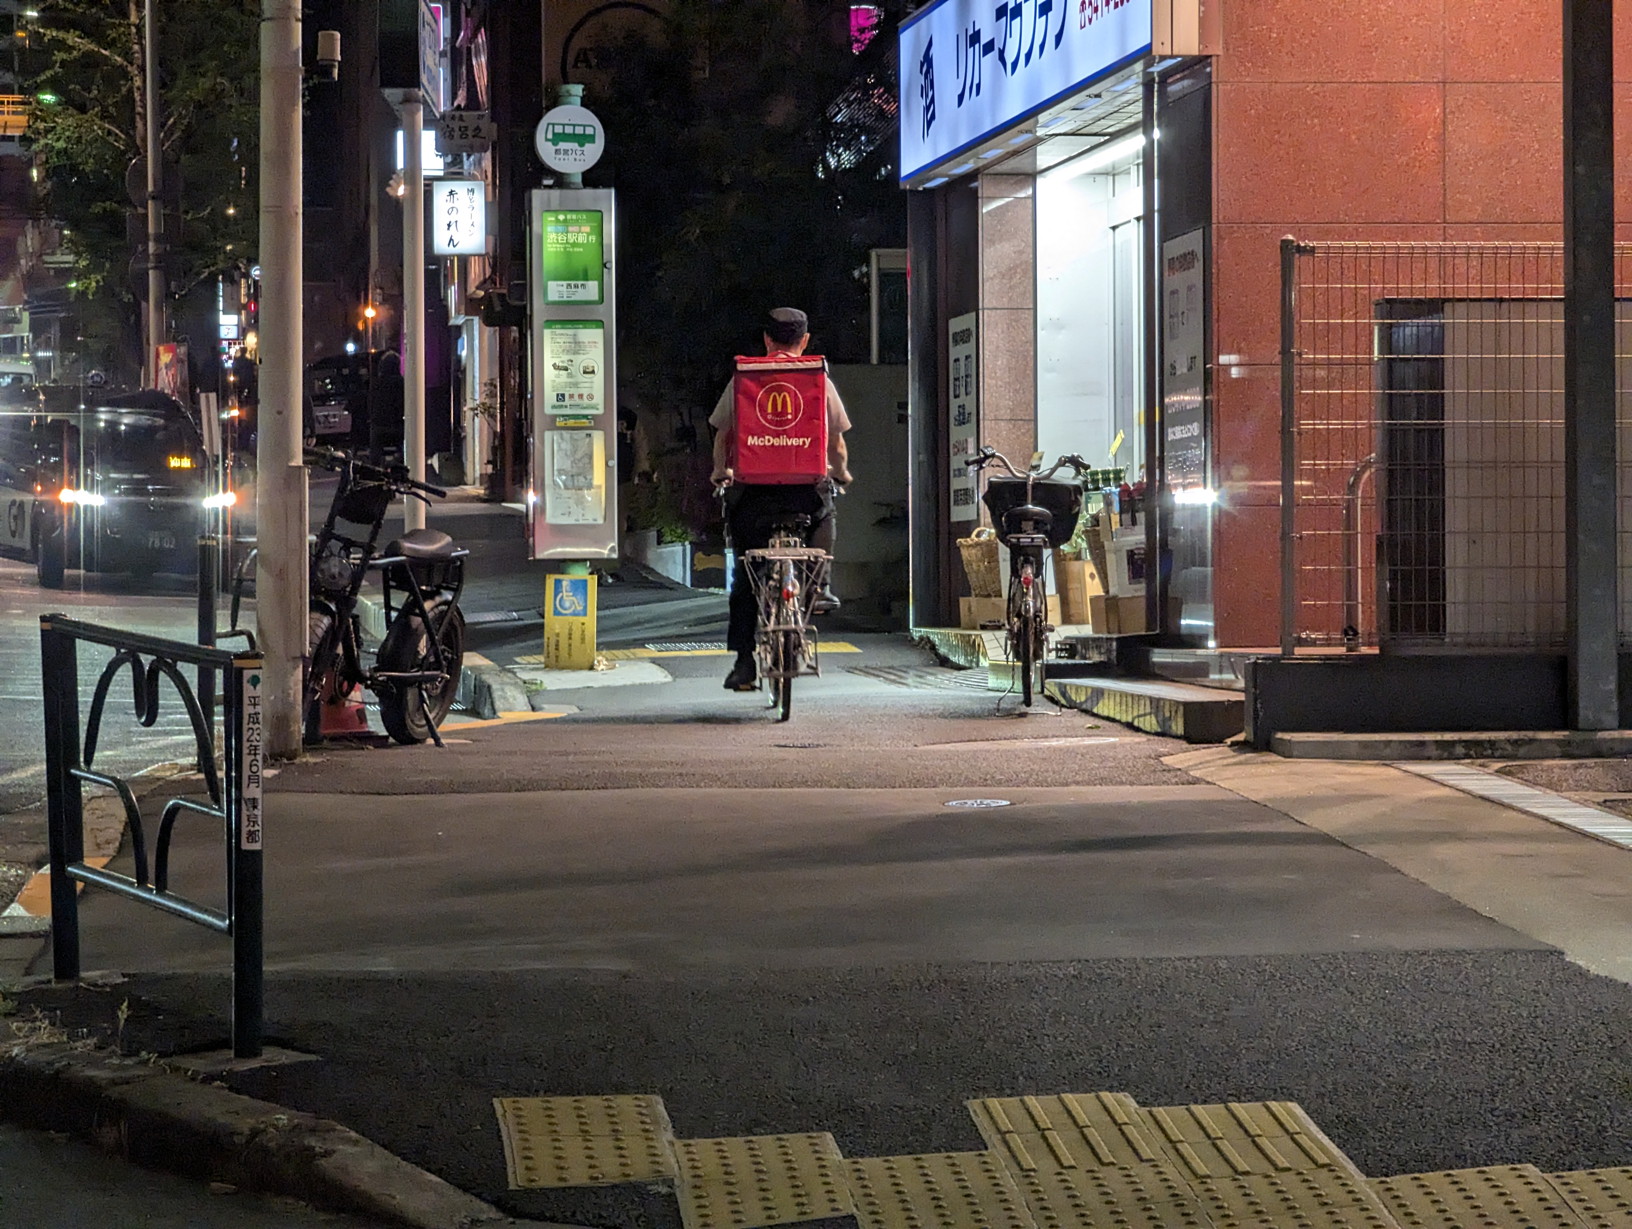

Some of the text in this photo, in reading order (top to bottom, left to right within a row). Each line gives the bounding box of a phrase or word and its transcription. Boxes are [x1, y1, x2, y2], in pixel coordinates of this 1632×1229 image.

[445, 188, 460, 249] 赤のれん
[547, 232, 587, 244] 渋谷駅前
[747, 435, 811, 448] McDelivery
[247, 695, 262, 790] 平成23年6月
